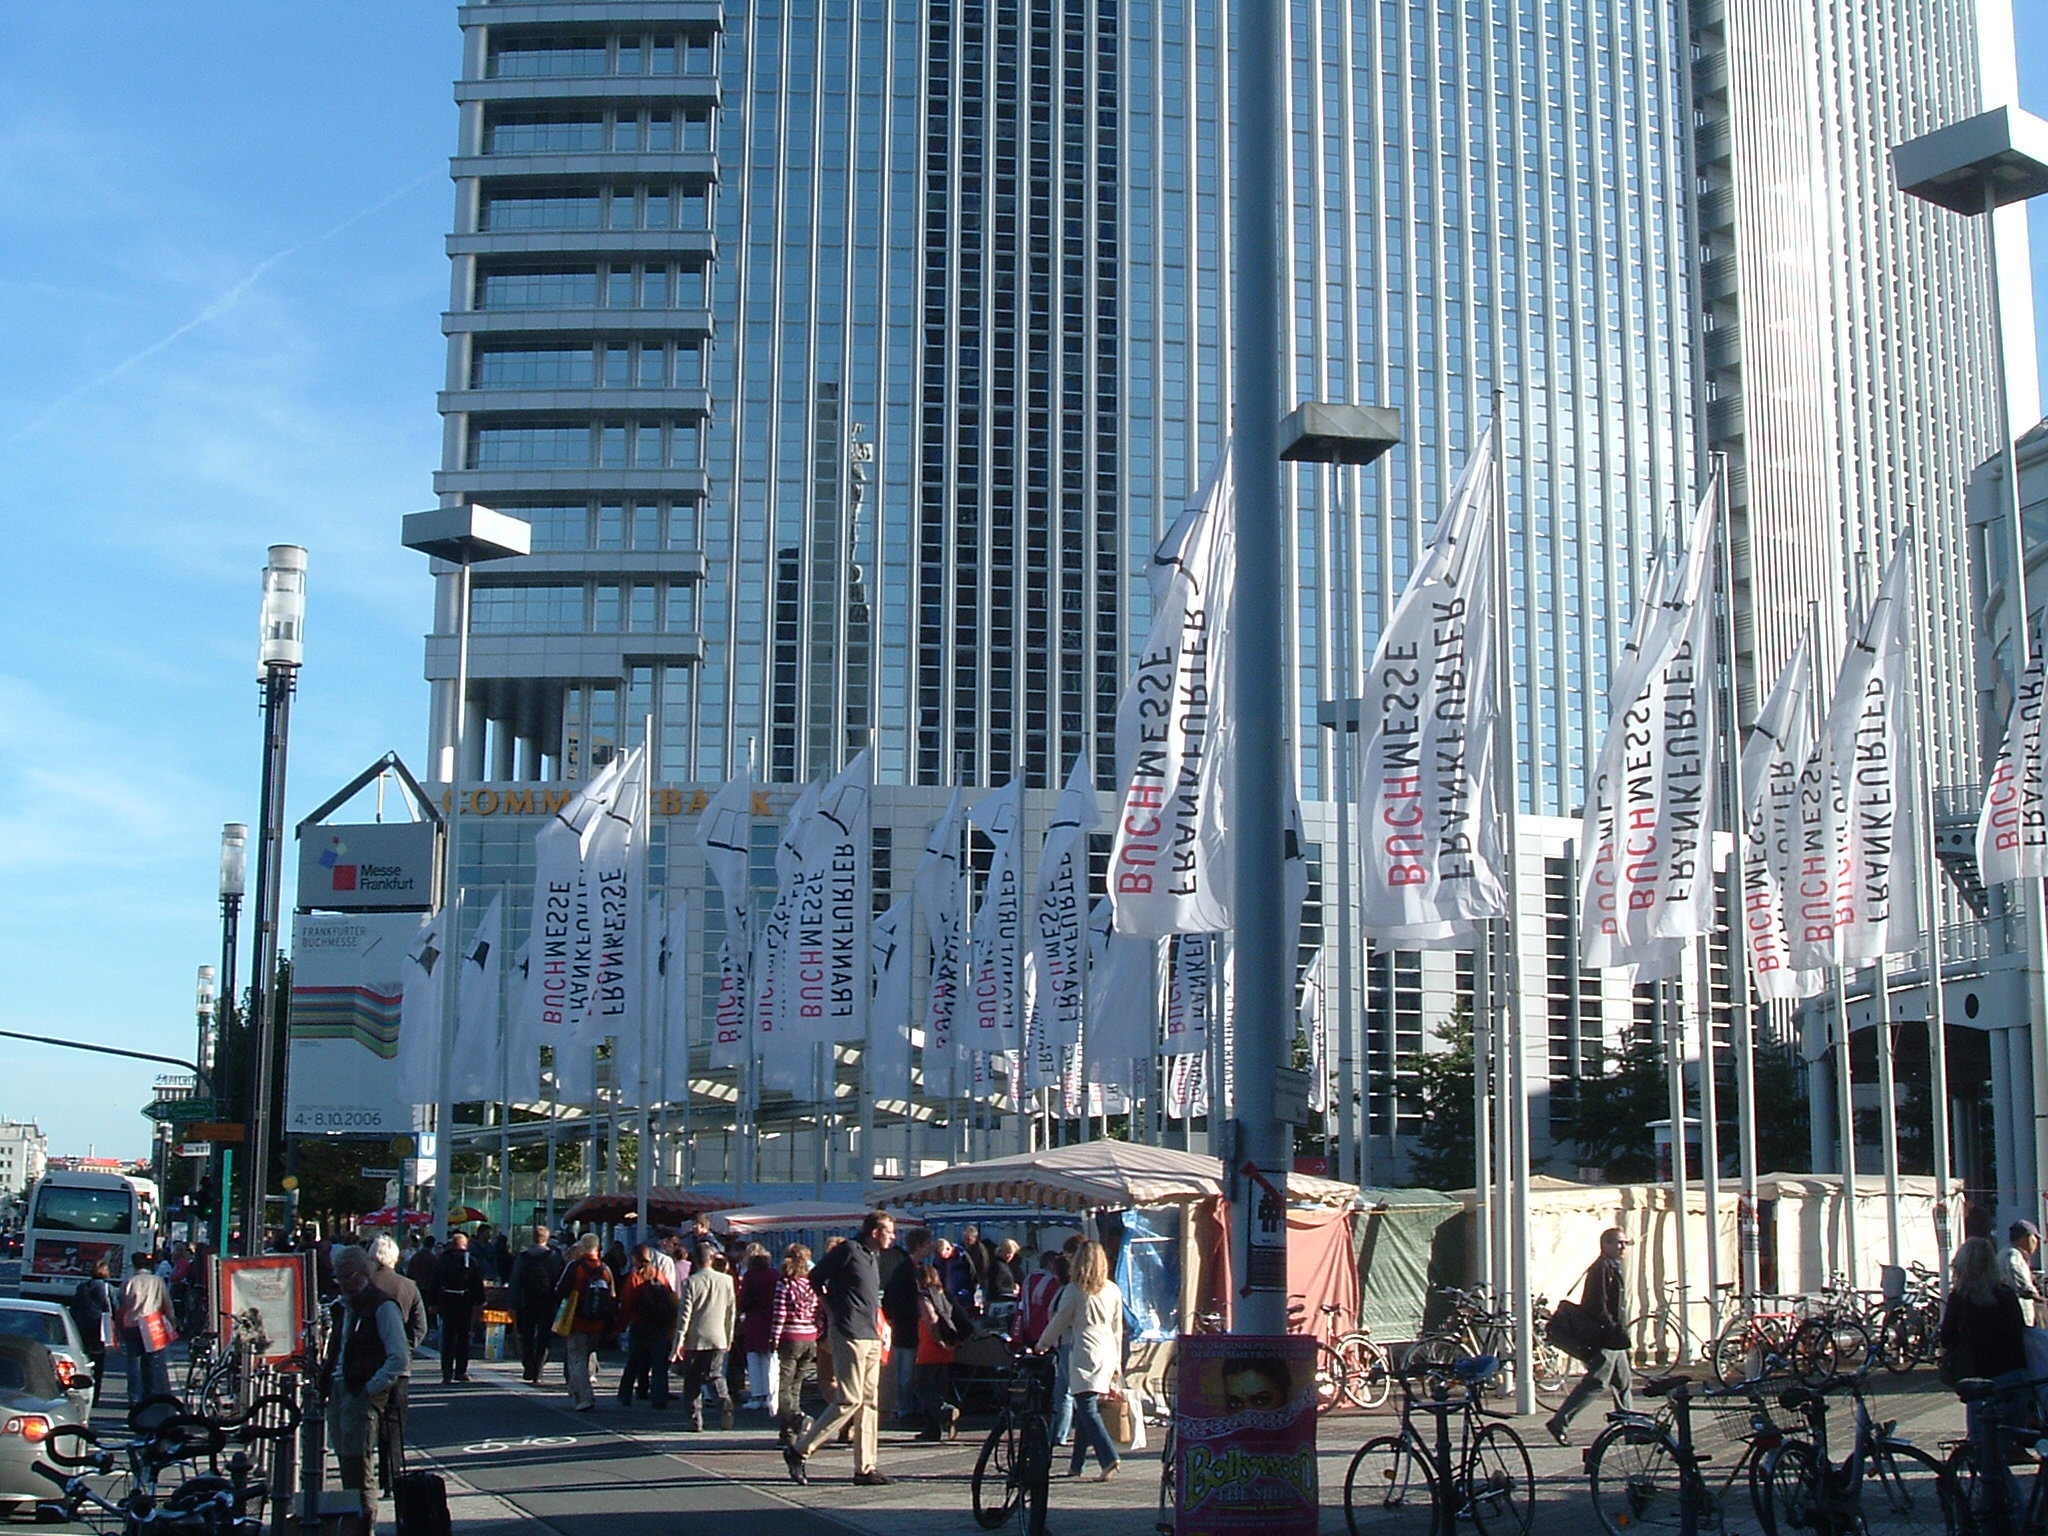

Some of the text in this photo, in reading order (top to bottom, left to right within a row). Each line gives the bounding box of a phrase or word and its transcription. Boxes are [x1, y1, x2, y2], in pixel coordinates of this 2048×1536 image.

[361, 865, 402, 876] Messe
[361, 877, 414, 891] Frankfurt
[302, 926, 366, 936] FRANKFURTER
[302, 937, 358, 948] BUCHMESSE
[1218, 1486, 1249, 1501] THE
